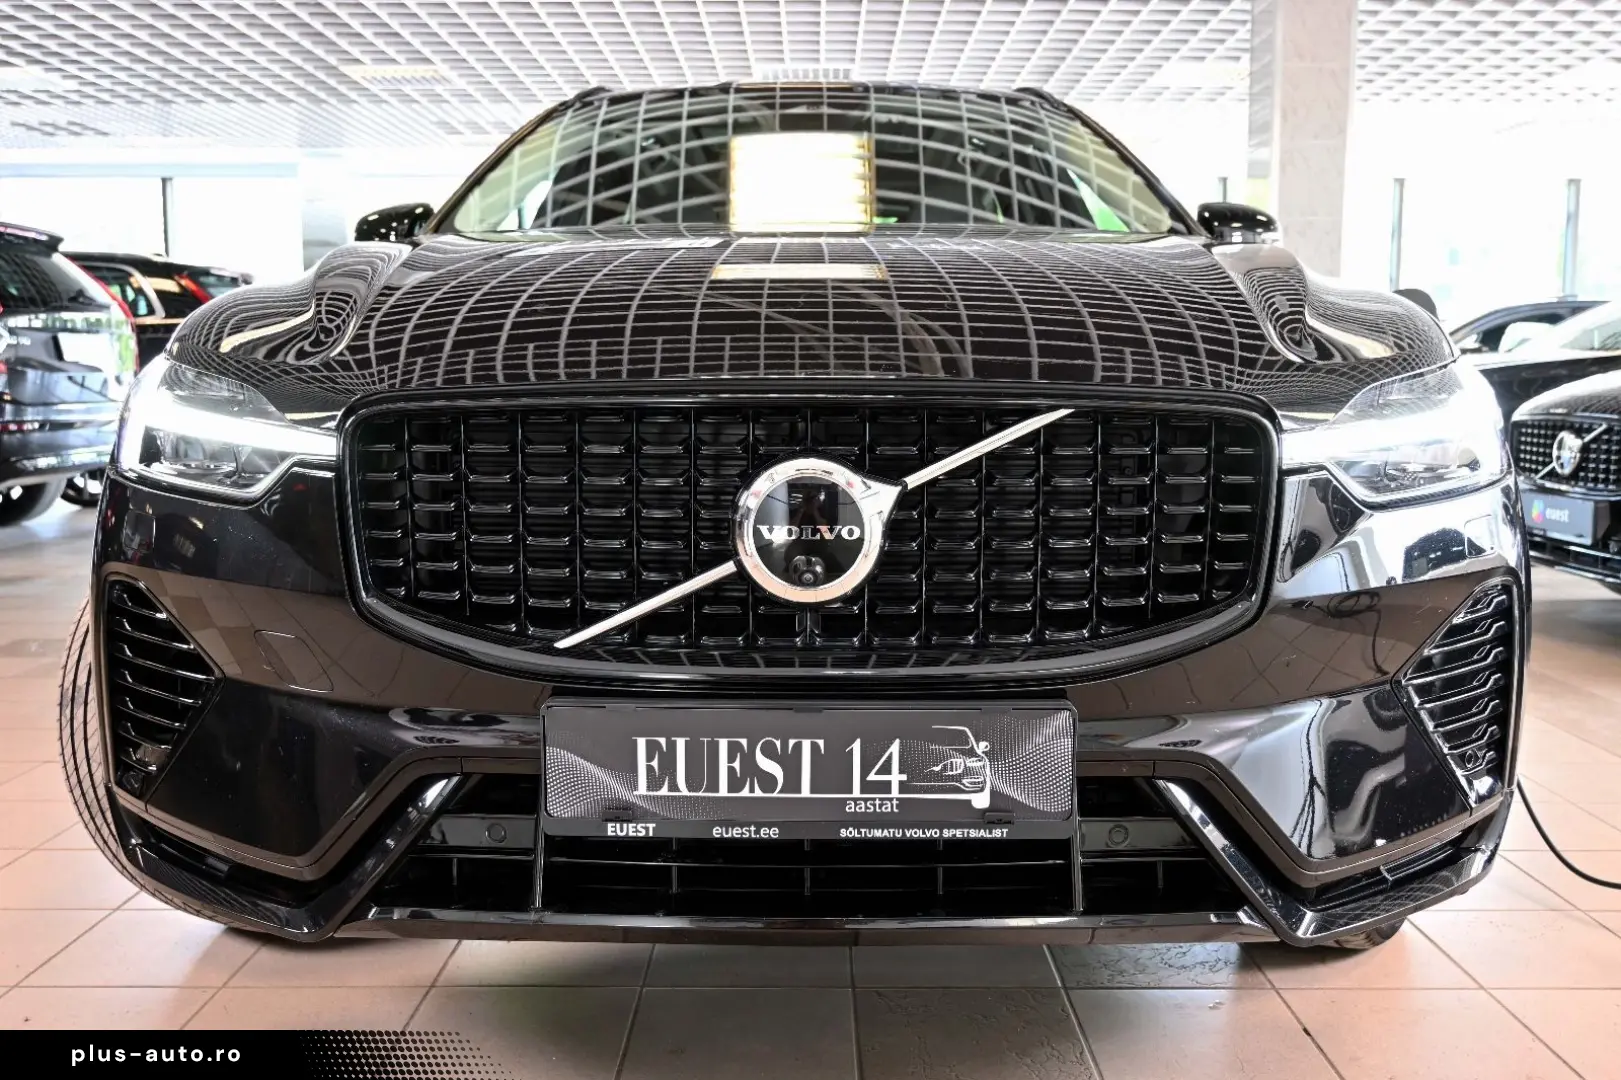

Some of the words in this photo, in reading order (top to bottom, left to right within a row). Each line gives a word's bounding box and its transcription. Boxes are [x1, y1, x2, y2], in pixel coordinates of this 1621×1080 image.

[756, 525, 861, 540] VOLVO
[632, 736, 825, 796] EUEST
[845, 737, 908, 797] 14
[845, 798, 900, 813] aastat
[607, 823, 656, 837] EUEST
[712, 825, 779, 838] euest.ee
[839, 827, 903, 838] SÕLTUMATU
[905, 828, 940, 838] VOLVO
[942, 828, 1008, 838] SPETSIALIST
